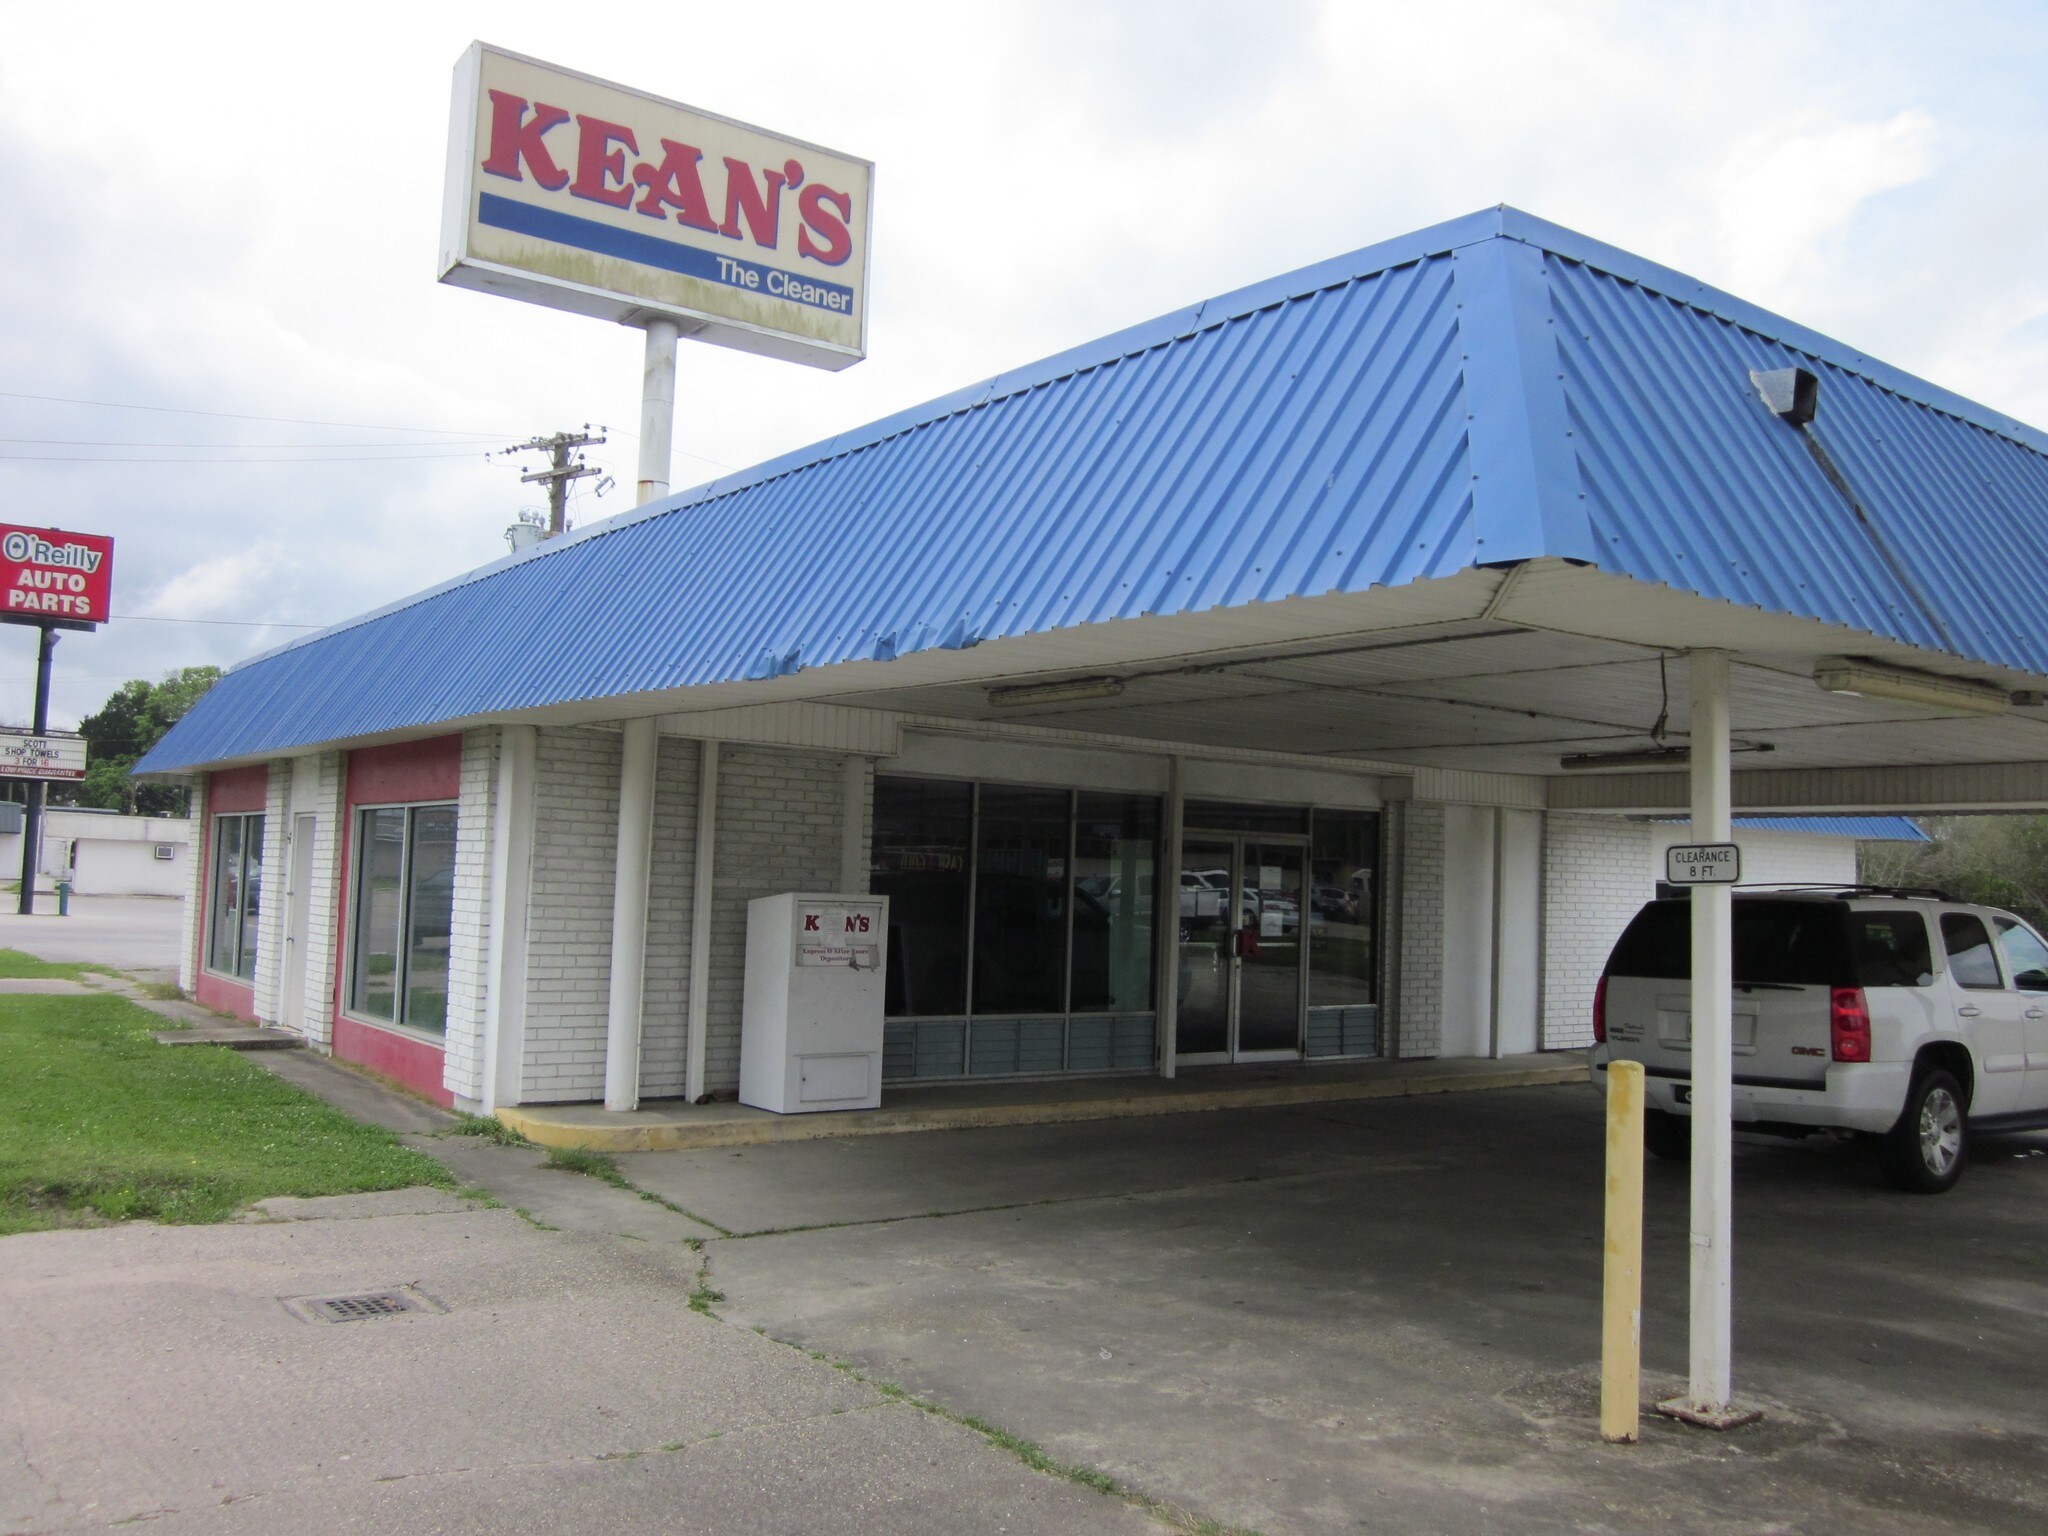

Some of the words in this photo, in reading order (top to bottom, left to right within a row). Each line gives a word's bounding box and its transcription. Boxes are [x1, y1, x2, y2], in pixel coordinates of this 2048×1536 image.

[481, 89, 852, 267] KEAN'S
[716, 256, 759, 288] The
[766, 270, 850, 312] Cleaner
[4, 533, 100, 572] O'Reilly
[17, 569, 86, 592] AUTO
[9, 589, 90, 614] PARTS
[24, 740, 47, 748] SCOTT
[5, 748, 26, 756] SHOP
[31, 749, 59, 758] TOWELS
[23, 758, 37, 766] FOR
[1675, 851, 1730, 863] CLEARANCE
[1690, 866, 1697, 877] 8
[1702, 866, 1716, 877] FT.
[804, 914, 870, 933] KN'S
[1791, 1044, 1826, 1057] GMC
